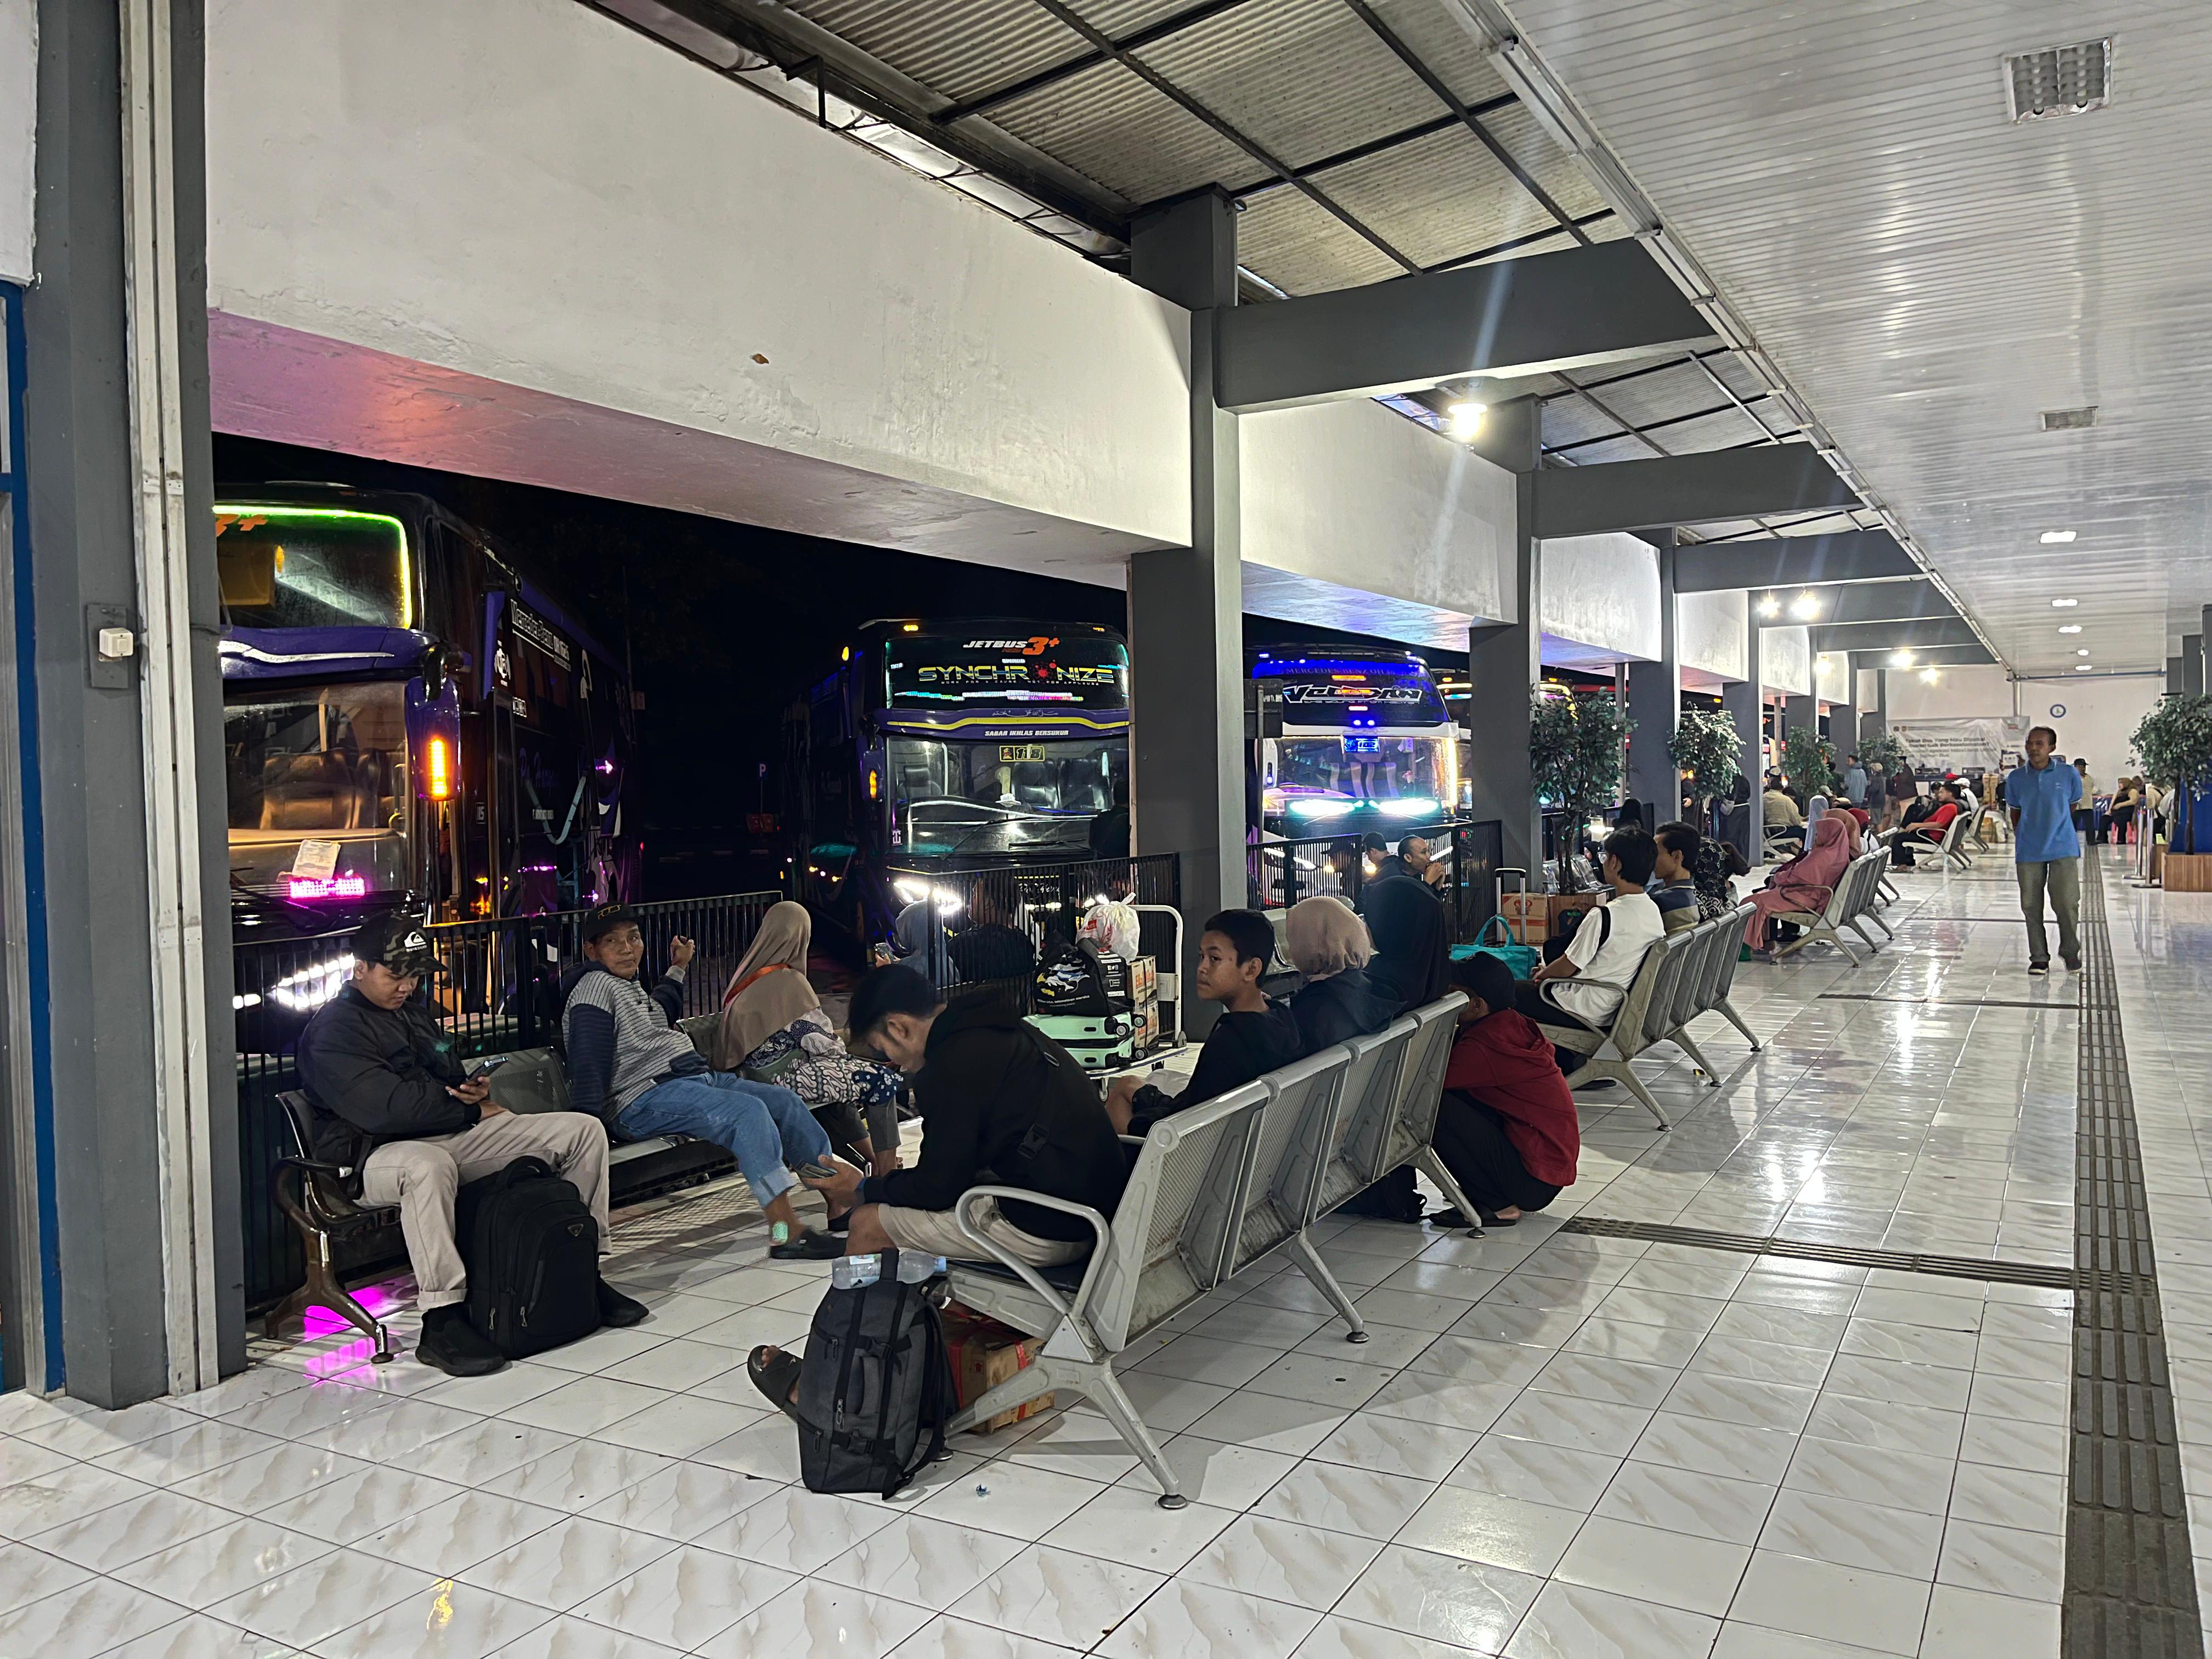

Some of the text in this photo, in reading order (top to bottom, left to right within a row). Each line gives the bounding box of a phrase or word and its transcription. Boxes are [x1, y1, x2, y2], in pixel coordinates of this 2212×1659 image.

[963, 636, 1060, 655] JETBUS 3+
[759, 763, 766, 777] P
